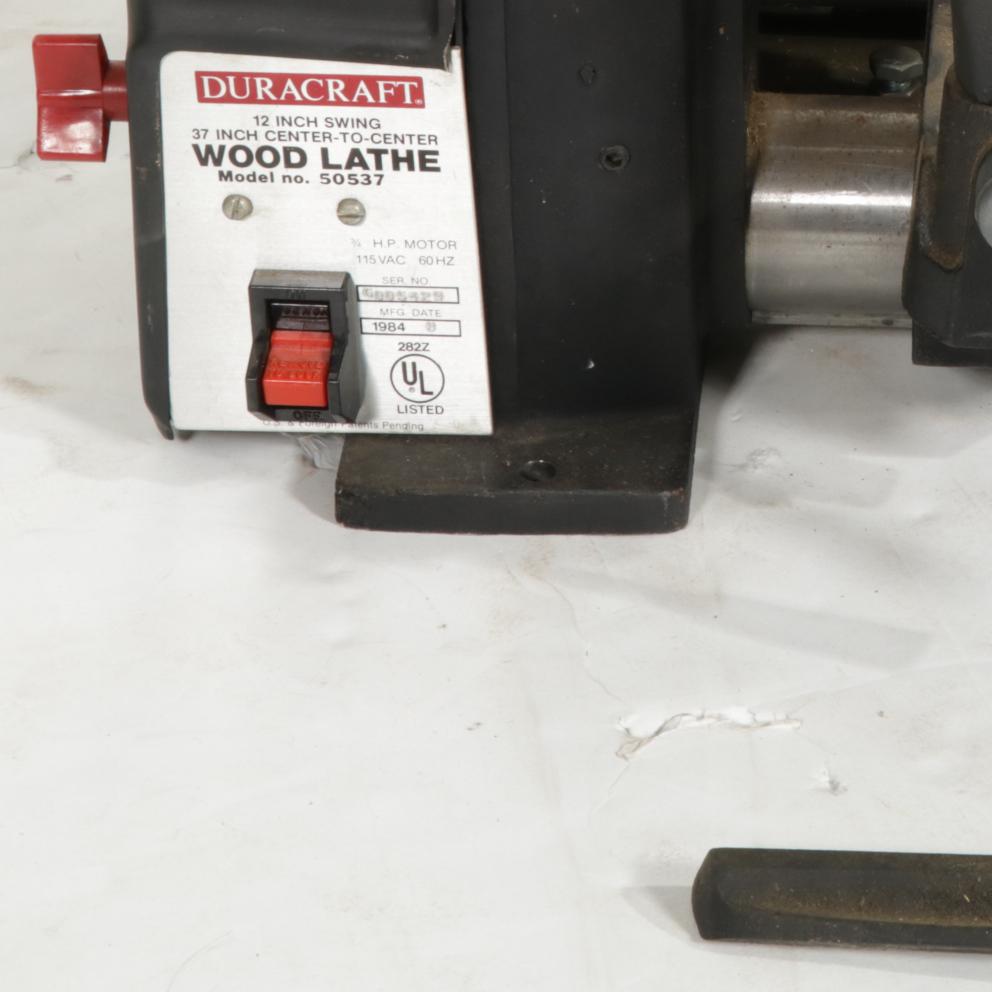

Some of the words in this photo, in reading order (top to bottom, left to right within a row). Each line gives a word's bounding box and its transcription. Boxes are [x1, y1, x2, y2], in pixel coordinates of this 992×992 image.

[200, 76, 418, 104] DURACRAFT
[253, 115, 269, 126] 12
[276, 116, 318, 127] INCH
[325, 117, 381, 129] SWING
[192, 128, 208, 140] 37
[216, 129, 258, 141] INCH
[265, 131, 438, 145] CENTER-TO-CENTER
[192, 144, 308, 169] WOOD
[320, 147, 441, 172] LATHE
[218, 170, 274, 183] Model
[282, 174, 309, 184] no.
[320, 174, 384, 186] 50537
[405, 240, 457, 250] MOTOR
[412, 309, 441, 317] DATE
[372, 322, 405, 332] 1984
[398, 342, 430, 351] 282Z
[401, 361, 434, 395] UL
[397, 405, 444, 414] LISTED
[382, 421, 424, 431] Pending
